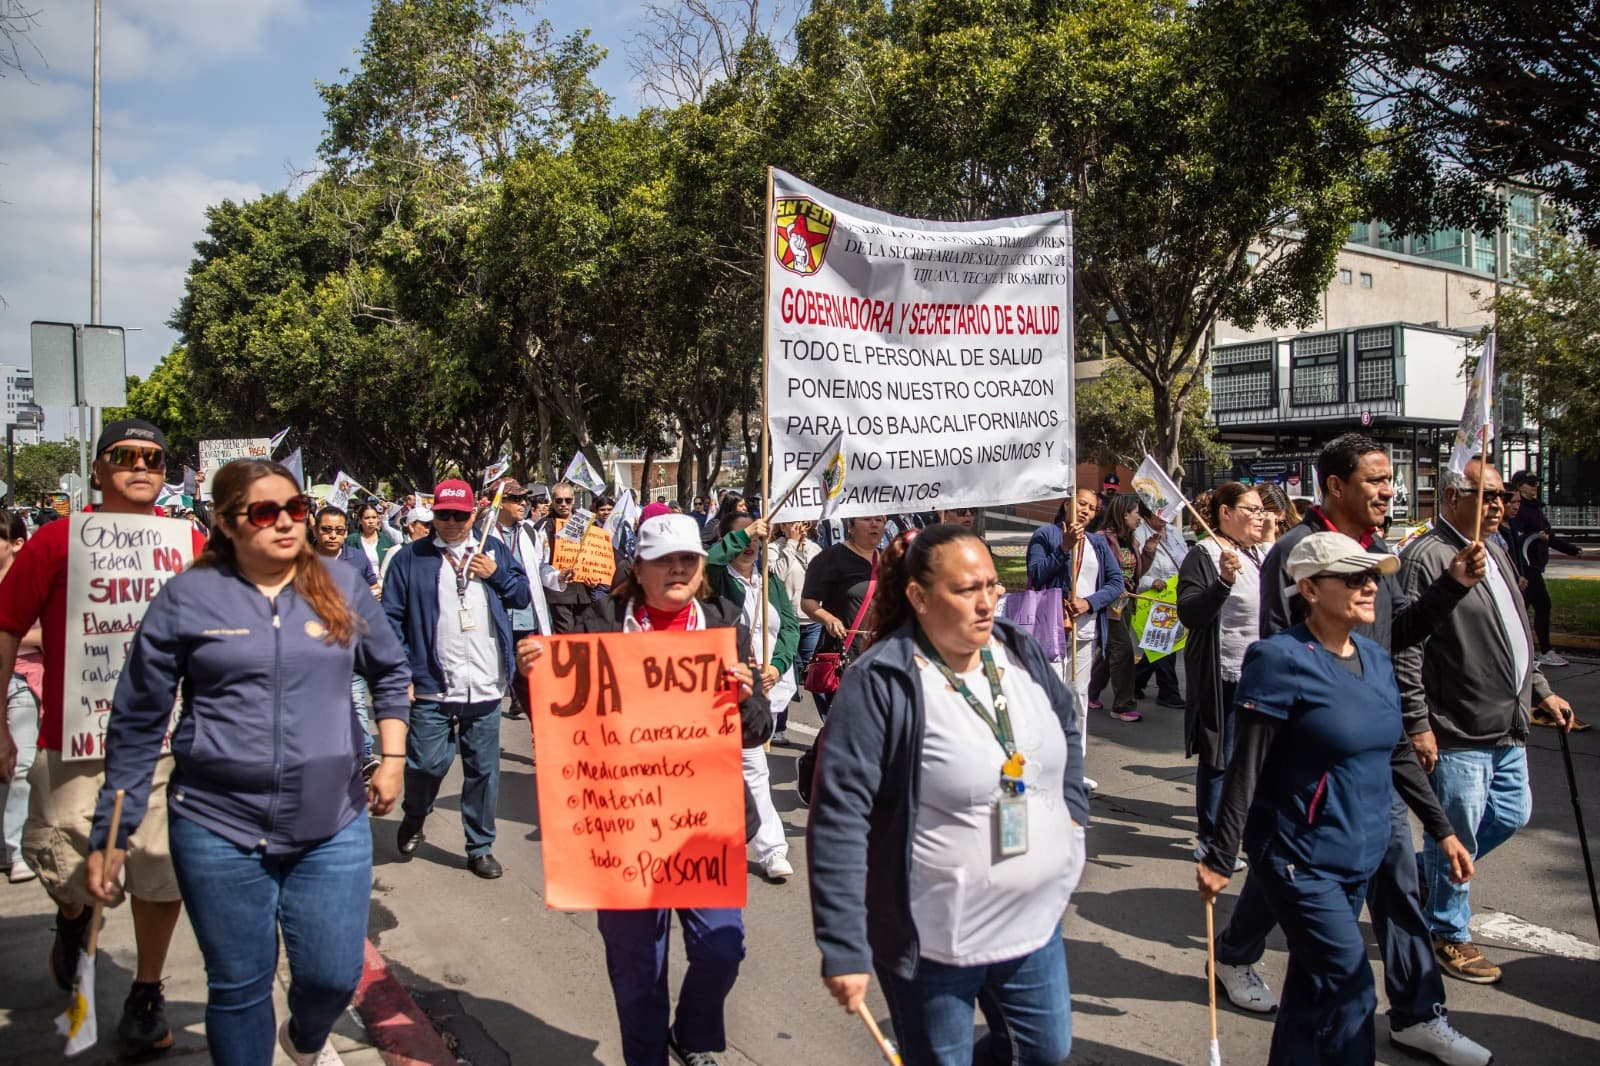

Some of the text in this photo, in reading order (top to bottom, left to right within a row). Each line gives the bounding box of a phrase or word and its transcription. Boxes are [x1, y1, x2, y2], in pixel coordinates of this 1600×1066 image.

[777, 200, 833, 226] SNTSA
[845, 239, 867, 255] DE
[868, 242, 886, 257] LA
[888, 245, 959, 264] SECRETARIA
[960, 252, 976, 264] DE
[1007, 272, 1066, 285] ROSARITO
[781, 287, 1060, 335] GOBERNADORA Y SECRETARIO DE SALUD
[780, 339, 1043, 367] TODO EL PERSONAL DE SALUD
[788, 377, 1054, 401] PONEMOS NUESTRO CORAZON
[786, 410, 1058, 436] PARA LOS BAJACALIFORNIANOS
[851, 451, 882, 471] NO
[887, 447, 973, 470] TENEMOS
[977, 442, 1041, 464] INSUMOS
[1045, 440, 1055, 459] Y
[81, 516, 162, 549] Gobierno
[90, 546, 183, 574] Federal NO
[84, 642, 109, 664] hay
[550, 638, 732, 717] YA BASTA
[573, 713, 737, 746] a la carencia de
[71, 733, 94, 757] NO
[576, 756, 695, 781] Medicamentos
[582, 786, 662, 811] Material
[585, 808, 708, 842] Equipo y sobre
[590, 844, 728, 887] todo Personal
